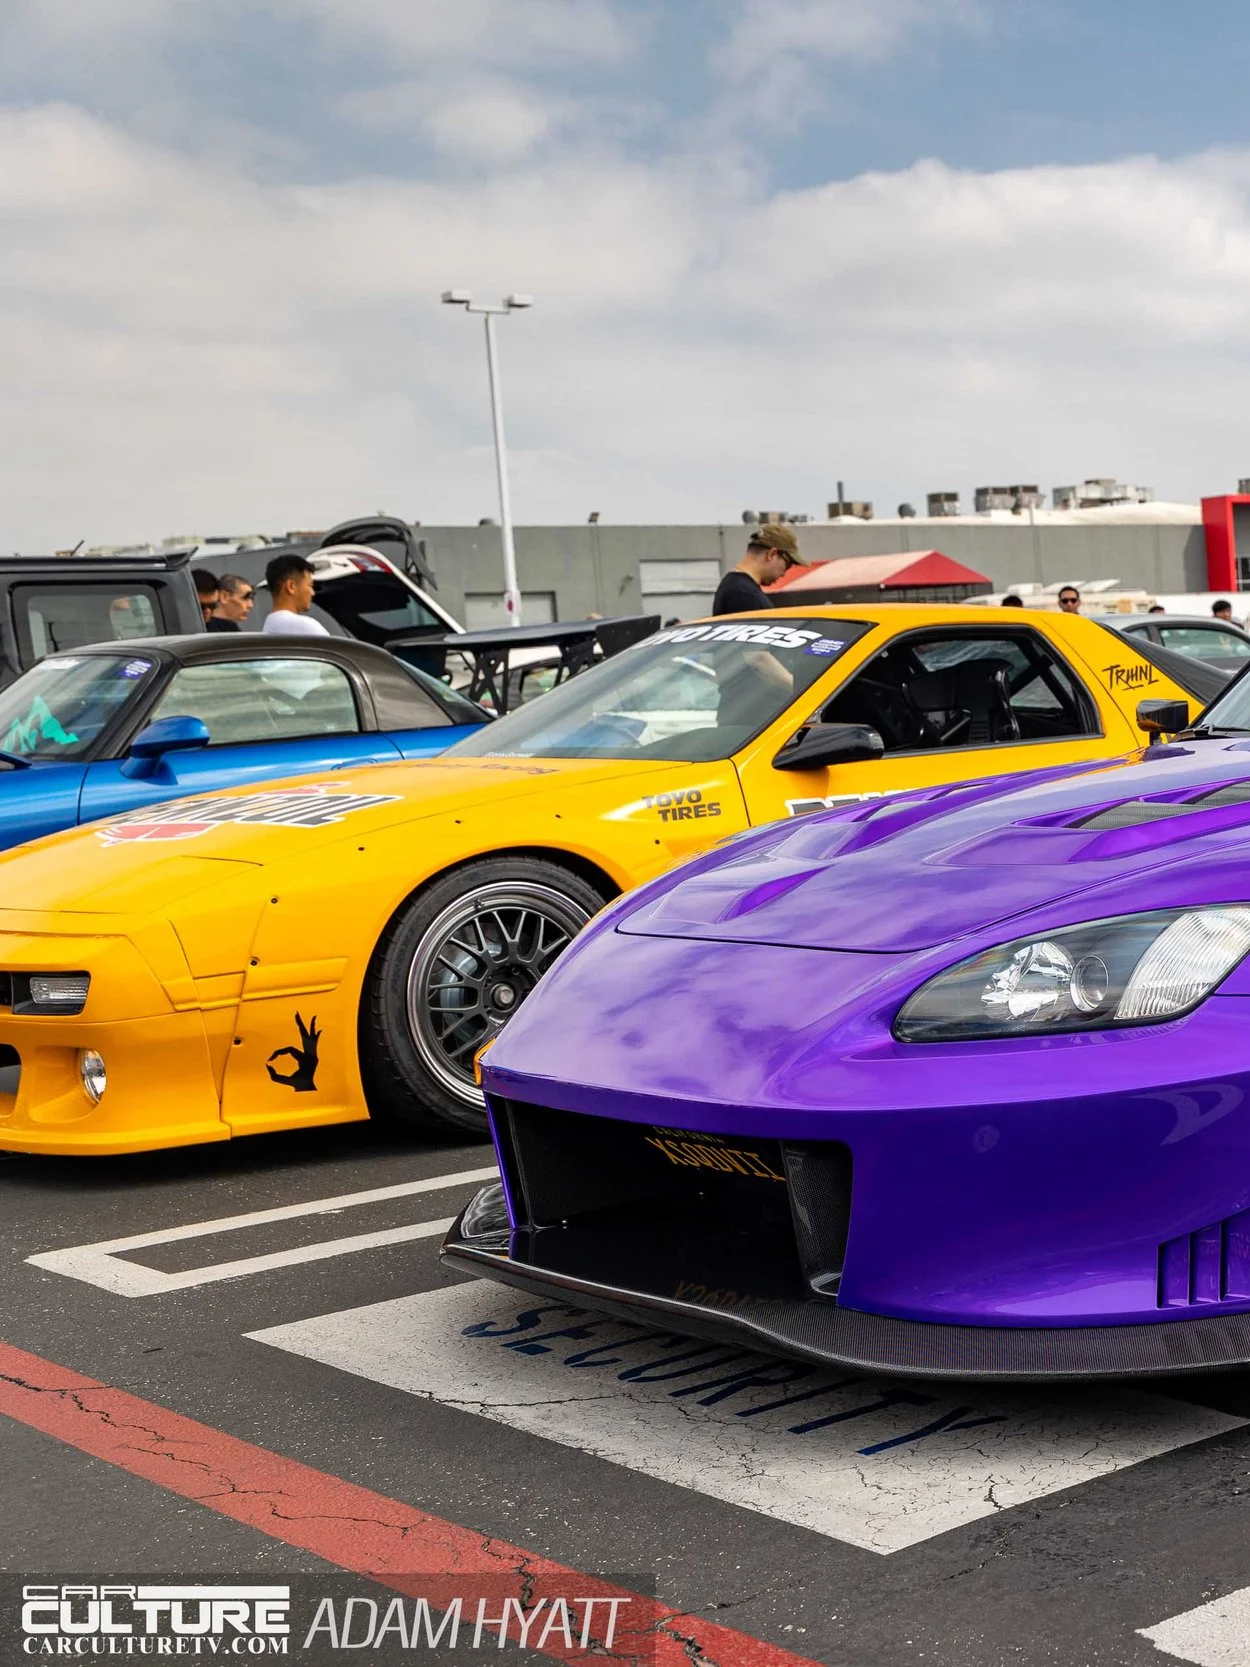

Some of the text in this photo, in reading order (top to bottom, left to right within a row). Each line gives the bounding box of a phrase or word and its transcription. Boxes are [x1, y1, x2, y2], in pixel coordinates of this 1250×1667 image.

[697, 624, 824, 649] TIRES
[641, 790, 703, 809] TOYO
[657, 802, 722, 823] TIRES
[460, 1304, 1008, 1456] SECURITY
